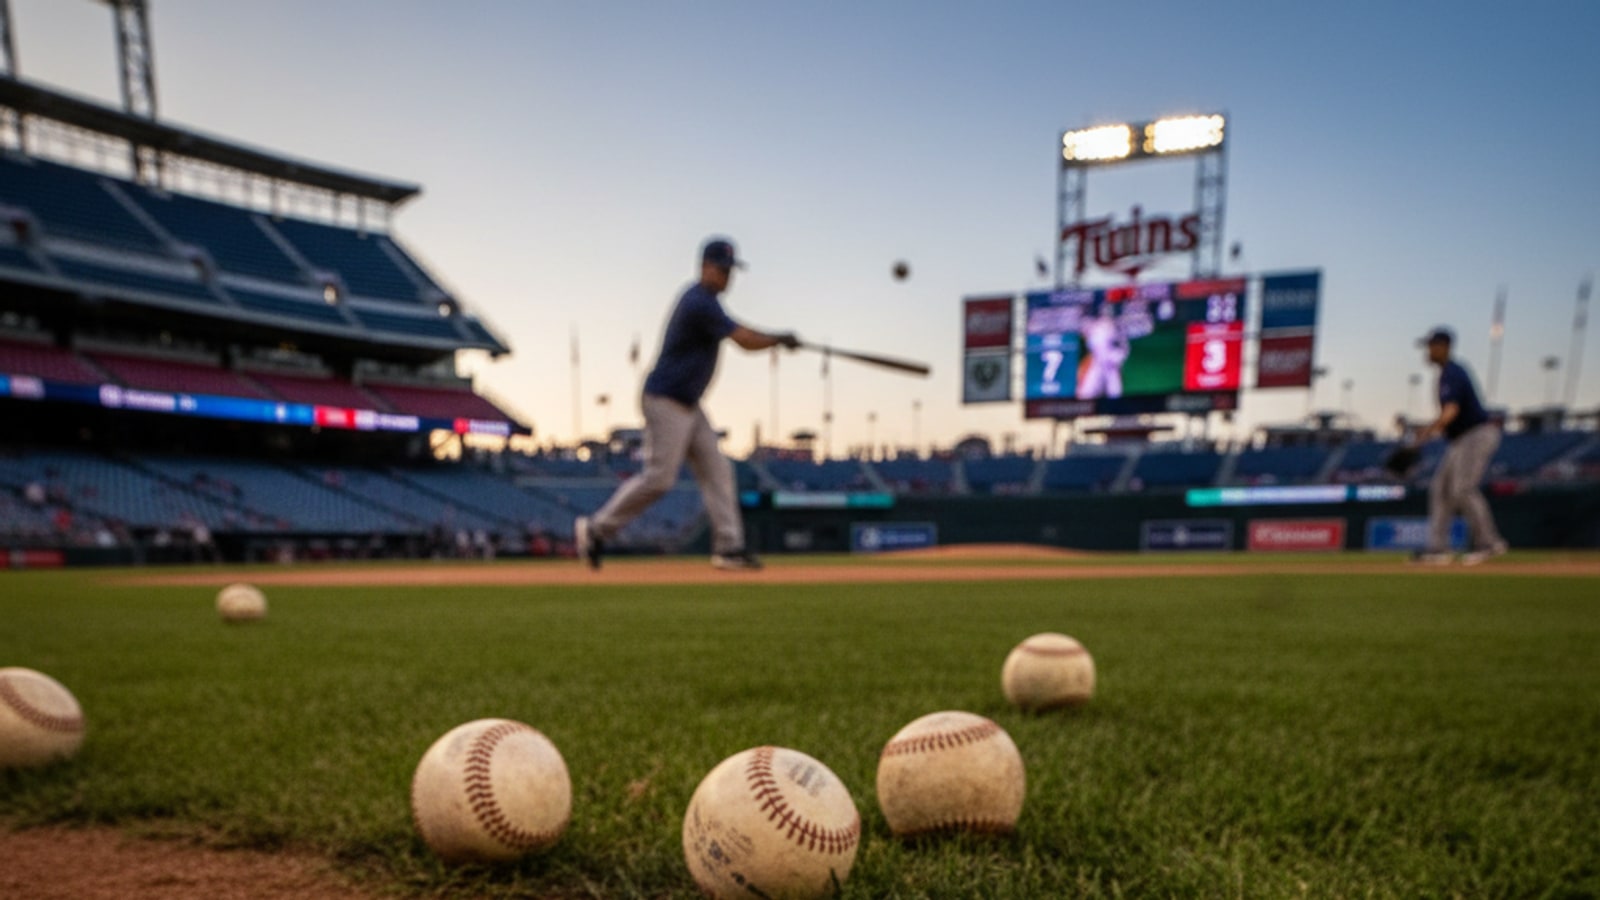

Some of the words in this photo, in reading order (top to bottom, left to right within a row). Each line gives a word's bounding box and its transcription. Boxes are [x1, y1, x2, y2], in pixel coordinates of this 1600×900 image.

[1061, 205, 1200, 272] Twins
[1041, 350, 1063, 381] 7
[1202, 339, 1227, 373] 3
